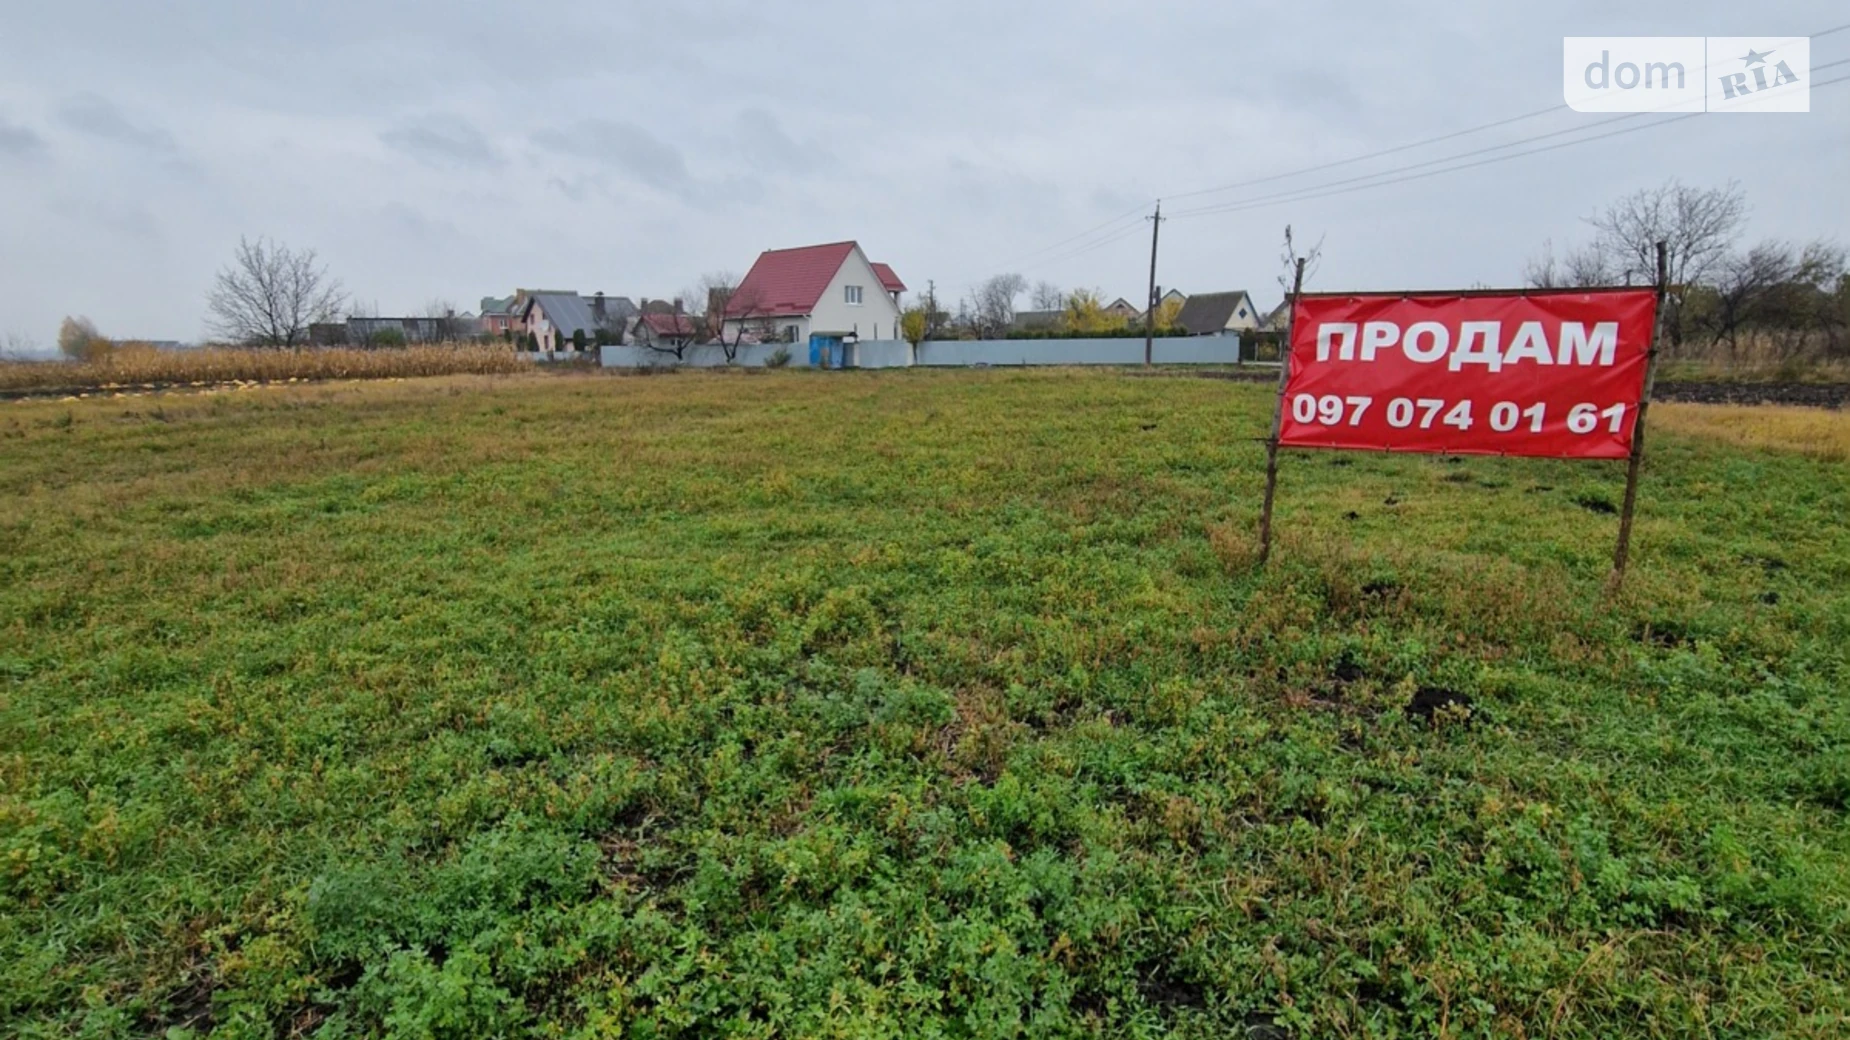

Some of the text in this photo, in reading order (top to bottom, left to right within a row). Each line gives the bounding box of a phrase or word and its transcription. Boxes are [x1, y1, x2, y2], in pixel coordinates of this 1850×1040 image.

[1316, 320, 1619, 372] ПРОДАМ
[1292, 393, 1626, 434] 097 074 01 61
